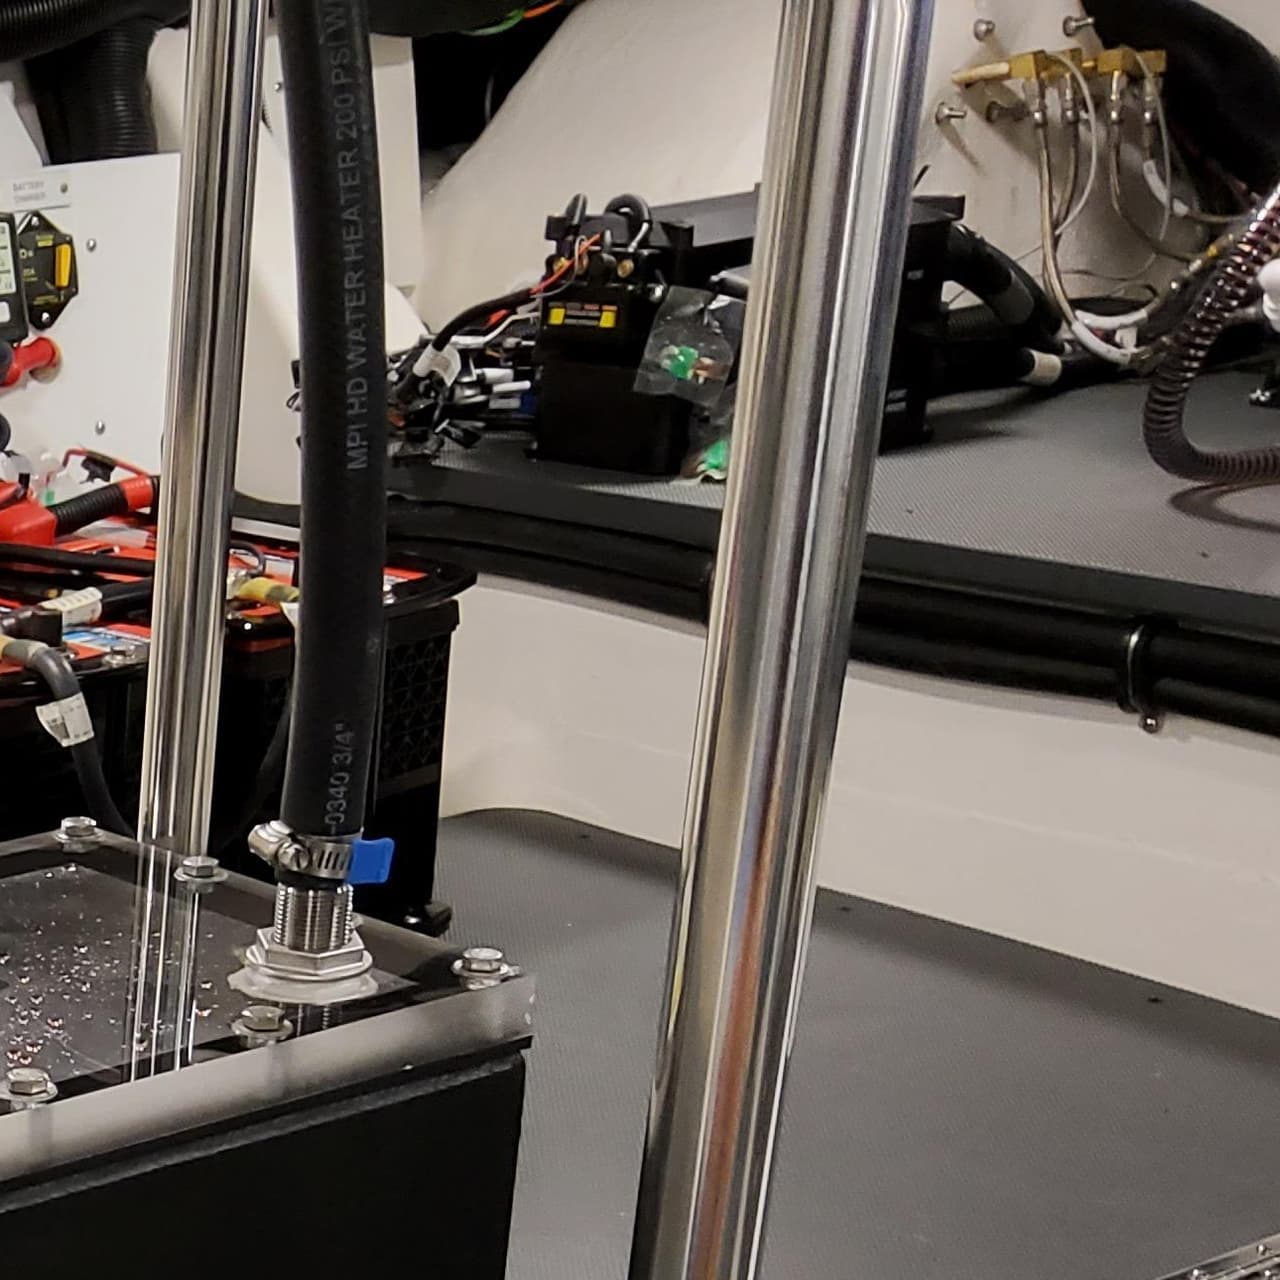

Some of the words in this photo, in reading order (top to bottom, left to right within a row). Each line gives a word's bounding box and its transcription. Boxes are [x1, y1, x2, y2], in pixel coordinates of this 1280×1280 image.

[327, 41, 352, 85] PSI
[333, 93, 357, 141] 200
[13, 181, 45, 192] BATTERY
[338, 148, 364, 262] HEATER
[344, 270, 367, 369] WATER
[347, 377, 368, 415] HD
[346, 423, 368, 469] MPI
